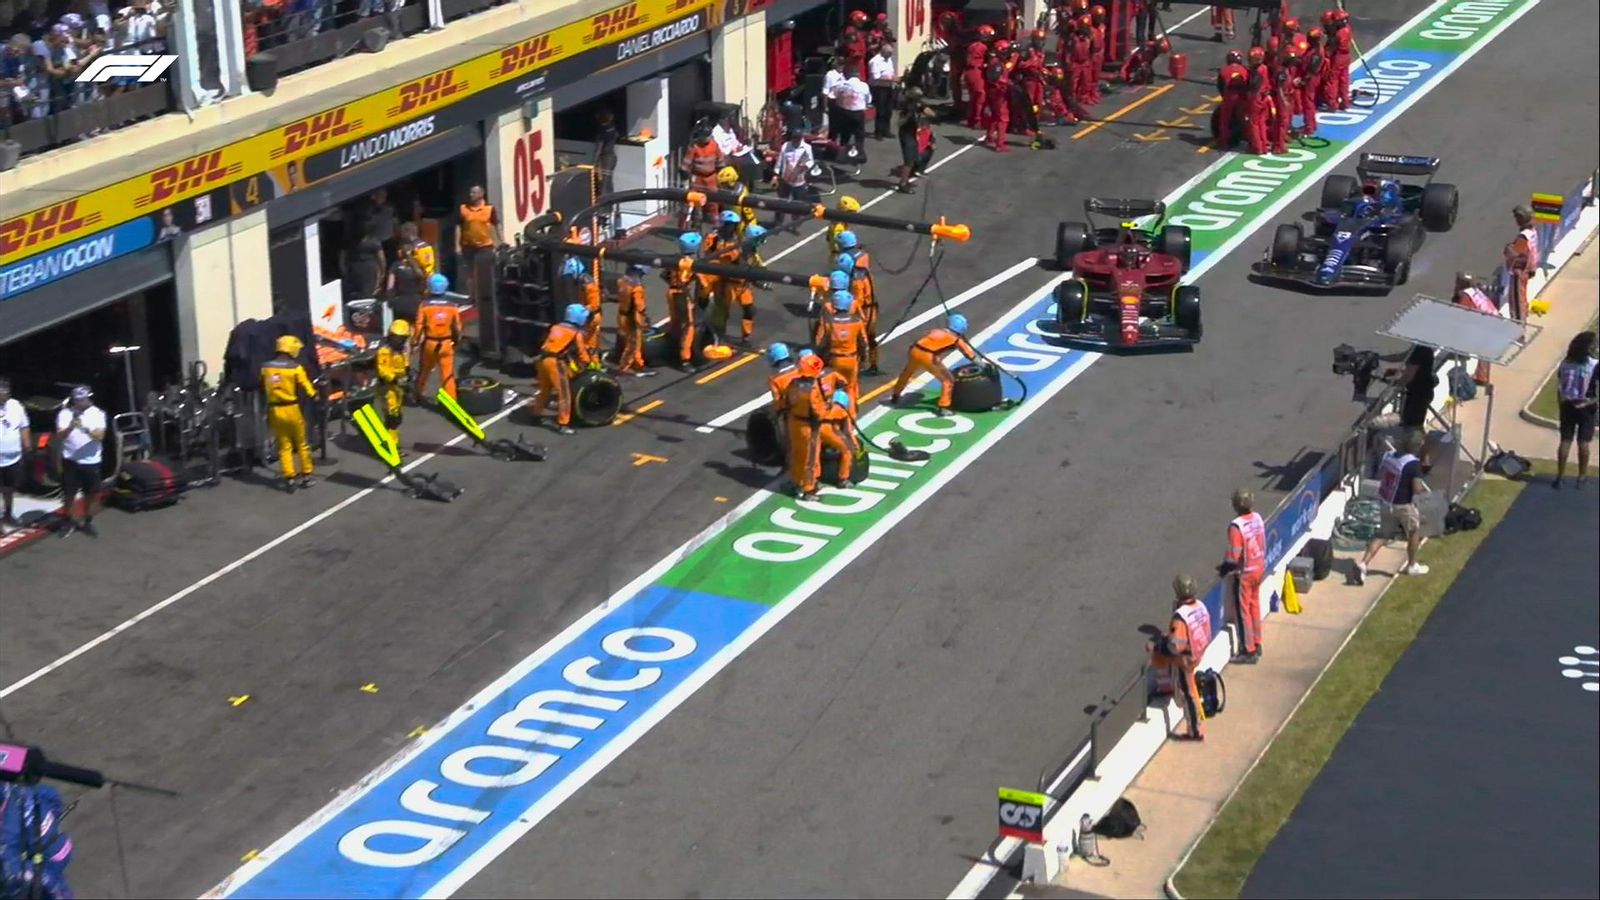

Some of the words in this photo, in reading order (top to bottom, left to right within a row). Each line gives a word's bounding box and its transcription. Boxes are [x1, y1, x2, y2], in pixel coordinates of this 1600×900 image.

[593, 3, 639, 40] DHL
[1419, 0, 1510, 40] aram
[501, 34, 553, 75] DHL
[616, 34, 651, 61] DANIEL
[399, 69, 458, 114] DHL
[284, 107, 350, 155] DHL
[340, 133, 388, 168] LANDO
[387, 115, 436, 150] NORRIS
[150, 150, 228, 203] DHL
[245, 176, 260, 205] 4
[513, 129, 545, 223] 05
[1168, 148, 1318, 231] aramco
[0, 200, 84, 256] DHL
[61, 234, 114, 272] OCON
[733, 411, 976, 562] aramco
[338, 626, 698, 868] aramco
